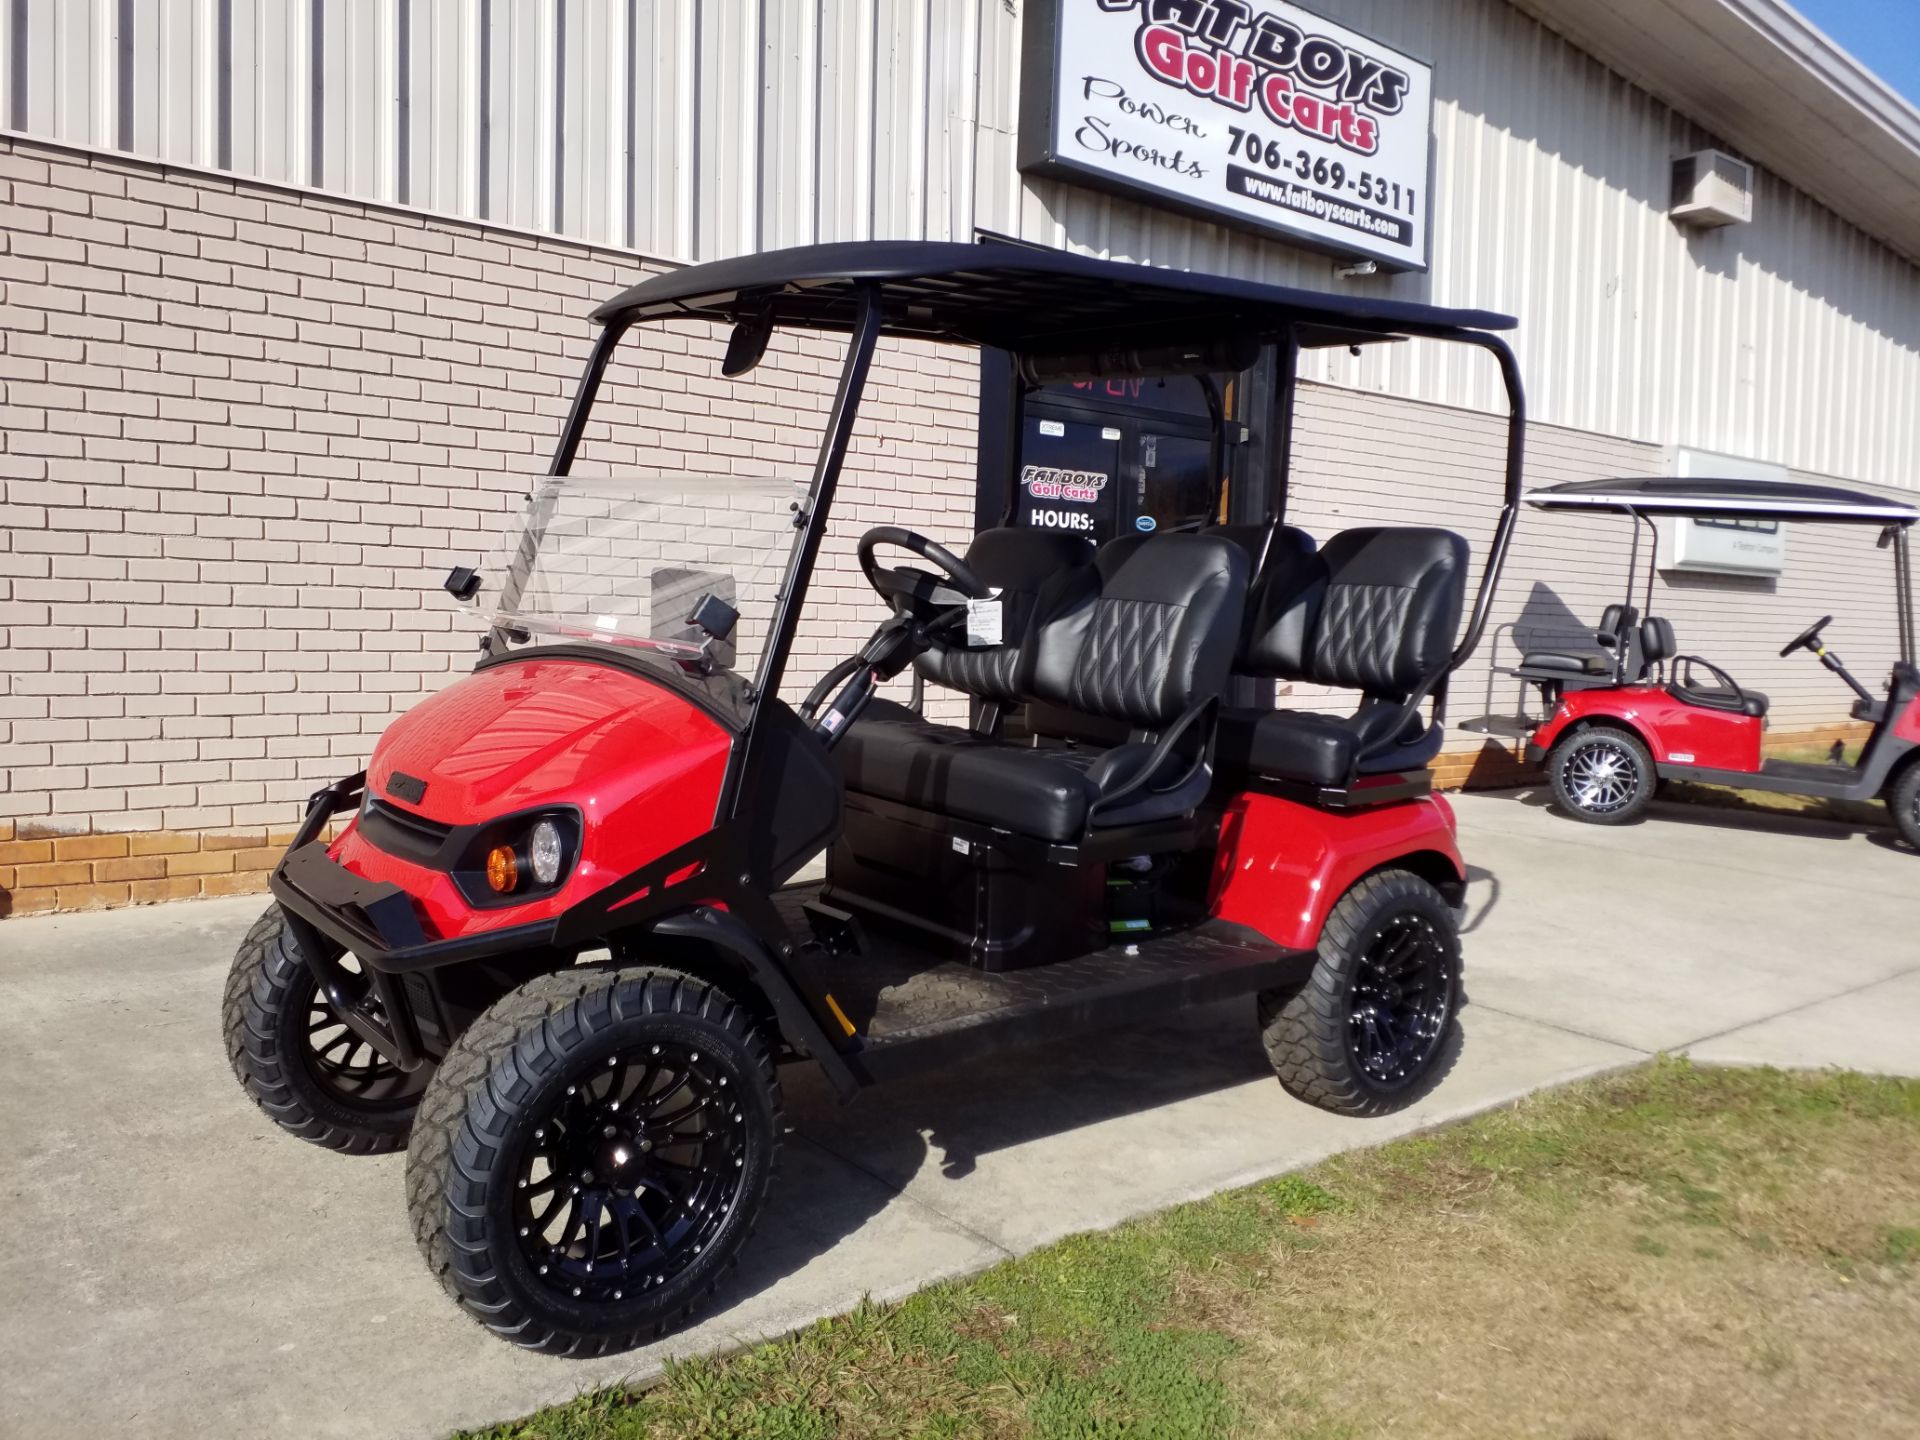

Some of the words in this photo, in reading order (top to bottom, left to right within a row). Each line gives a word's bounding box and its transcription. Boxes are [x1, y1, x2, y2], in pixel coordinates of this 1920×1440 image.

[1098, 0, 1250, 46] AT
[1250, 14, 1408, 112] BOYS
[1082, 76, 1207, 138] Power
[1144, 28, 1253, 107] Golf
[1264, 75, 1375, 150] Carts
[1075, 116, 1210, 178] Sports
[1228, 126, 1415, 216] 706-369-5311
[1245, 176, 1399, 238] www.fatboyscarts.com
[1023, 467, 1061, 482] FAT
[1060, 472, 1107, 488] BOYS
[1031, 483, 1061, 497] Golf
[1062, 486, 1097, 500] Carts
[1031, 509, 1094, 530] HOURS:
